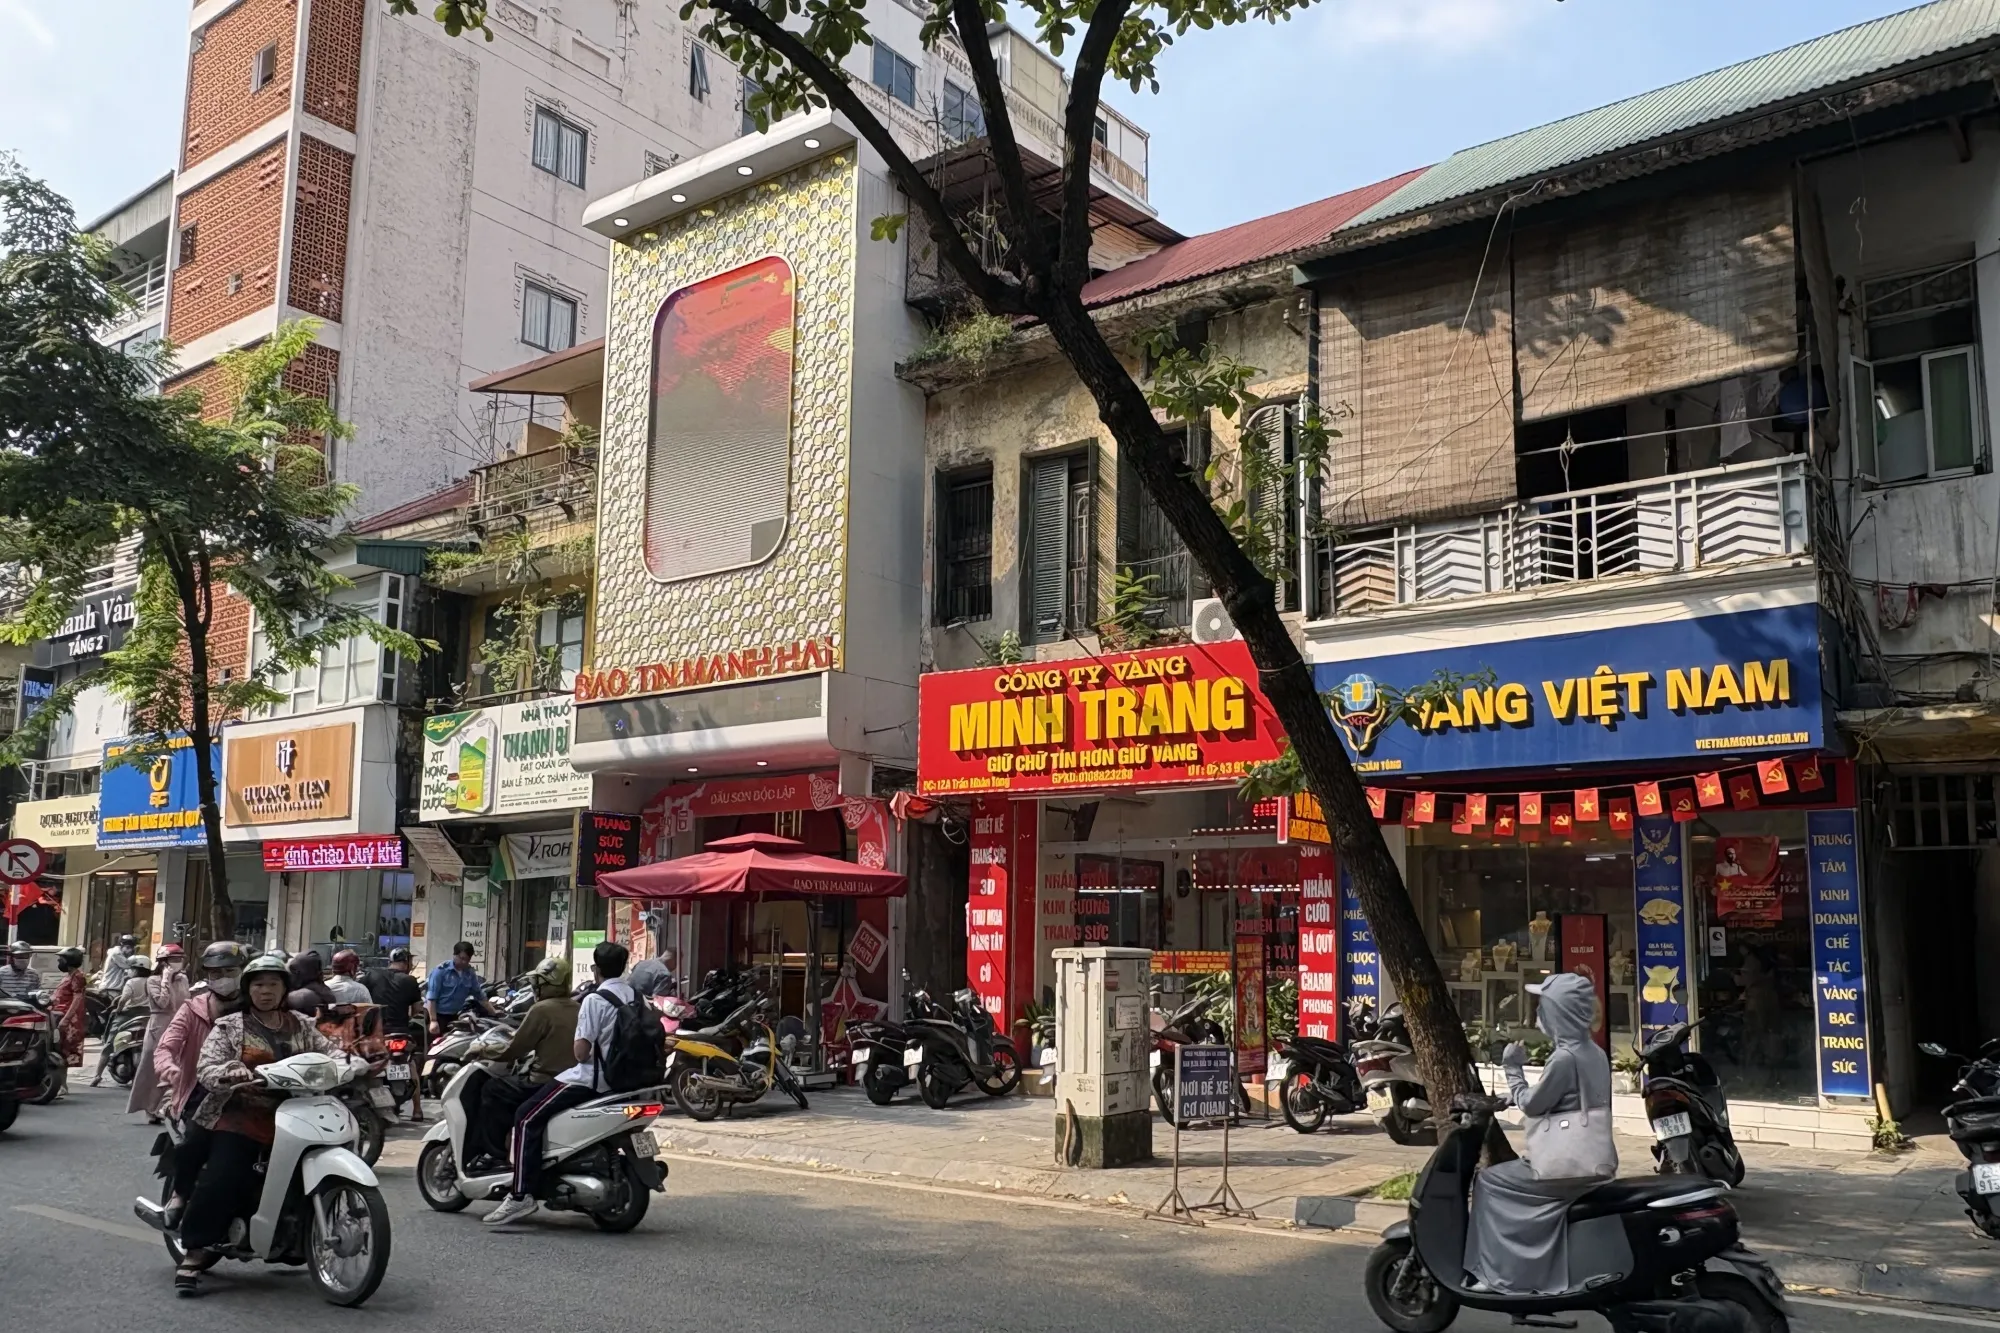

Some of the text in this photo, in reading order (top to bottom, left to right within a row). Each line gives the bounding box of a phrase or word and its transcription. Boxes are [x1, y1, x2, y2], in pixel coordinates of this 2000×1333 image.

[96, 635, 104, 650] 2
[994, 654, 1187, 693] CÔNG TY VÀNG
[1541, 664, 1650, 725] VIỆT
[1666, 658, 1790, 710] NAM
[521, 698, 571, 722] NHÀ THUỐ
[950, 677, 1245, 752] MINH TRANG
[1695, 731, 1809, 750] VIETNAMGOLD.COM.VN
[987, 741, 1198, 773] GIỮ CHỮ TÍN HƠN GIỮ VÀNG
[593, 816, 631, 831] TRANG
[599, 835, 624, 849] SỨC
[1812, 834, 1852, 847] TRUNG
[312, 843, 345, 865] chào
[347, 842, 375, 869] Quý
[594, 852, 626, 866] VÀNG
[1820, 857, 1847, 874] TÂM
[980, 879, 996, 896] 3D
[1820, 888, 1850, 902] KINH
[1815, 913, 1858, 925] DOANH
[1302, 930, 1315, 953] ĐÁ
[1352, 931, 1370, 942] SJC
[1825, 933, 1851, 950] CHẾ
[1827, 957, 1851, 974] TÁC
[1301, 971, 1333, 992] CHARM
[1351, 973, 1375, 986] NHÀ
[1823, 983, 1858, 1001] VÀNG
[1303, 999, 1333, 1014] PHONG
[1828, 1012, 1855, 1026] BẠC
[1822, 1036, 1864, 1051] TRANG
[1831, 1057, 1858, 1074] SỨC
[1181, 1075, 1229, 1097] NƠI ĐỂ XE
[1183, 1100, 1226, 1118] CƠ QUAN
